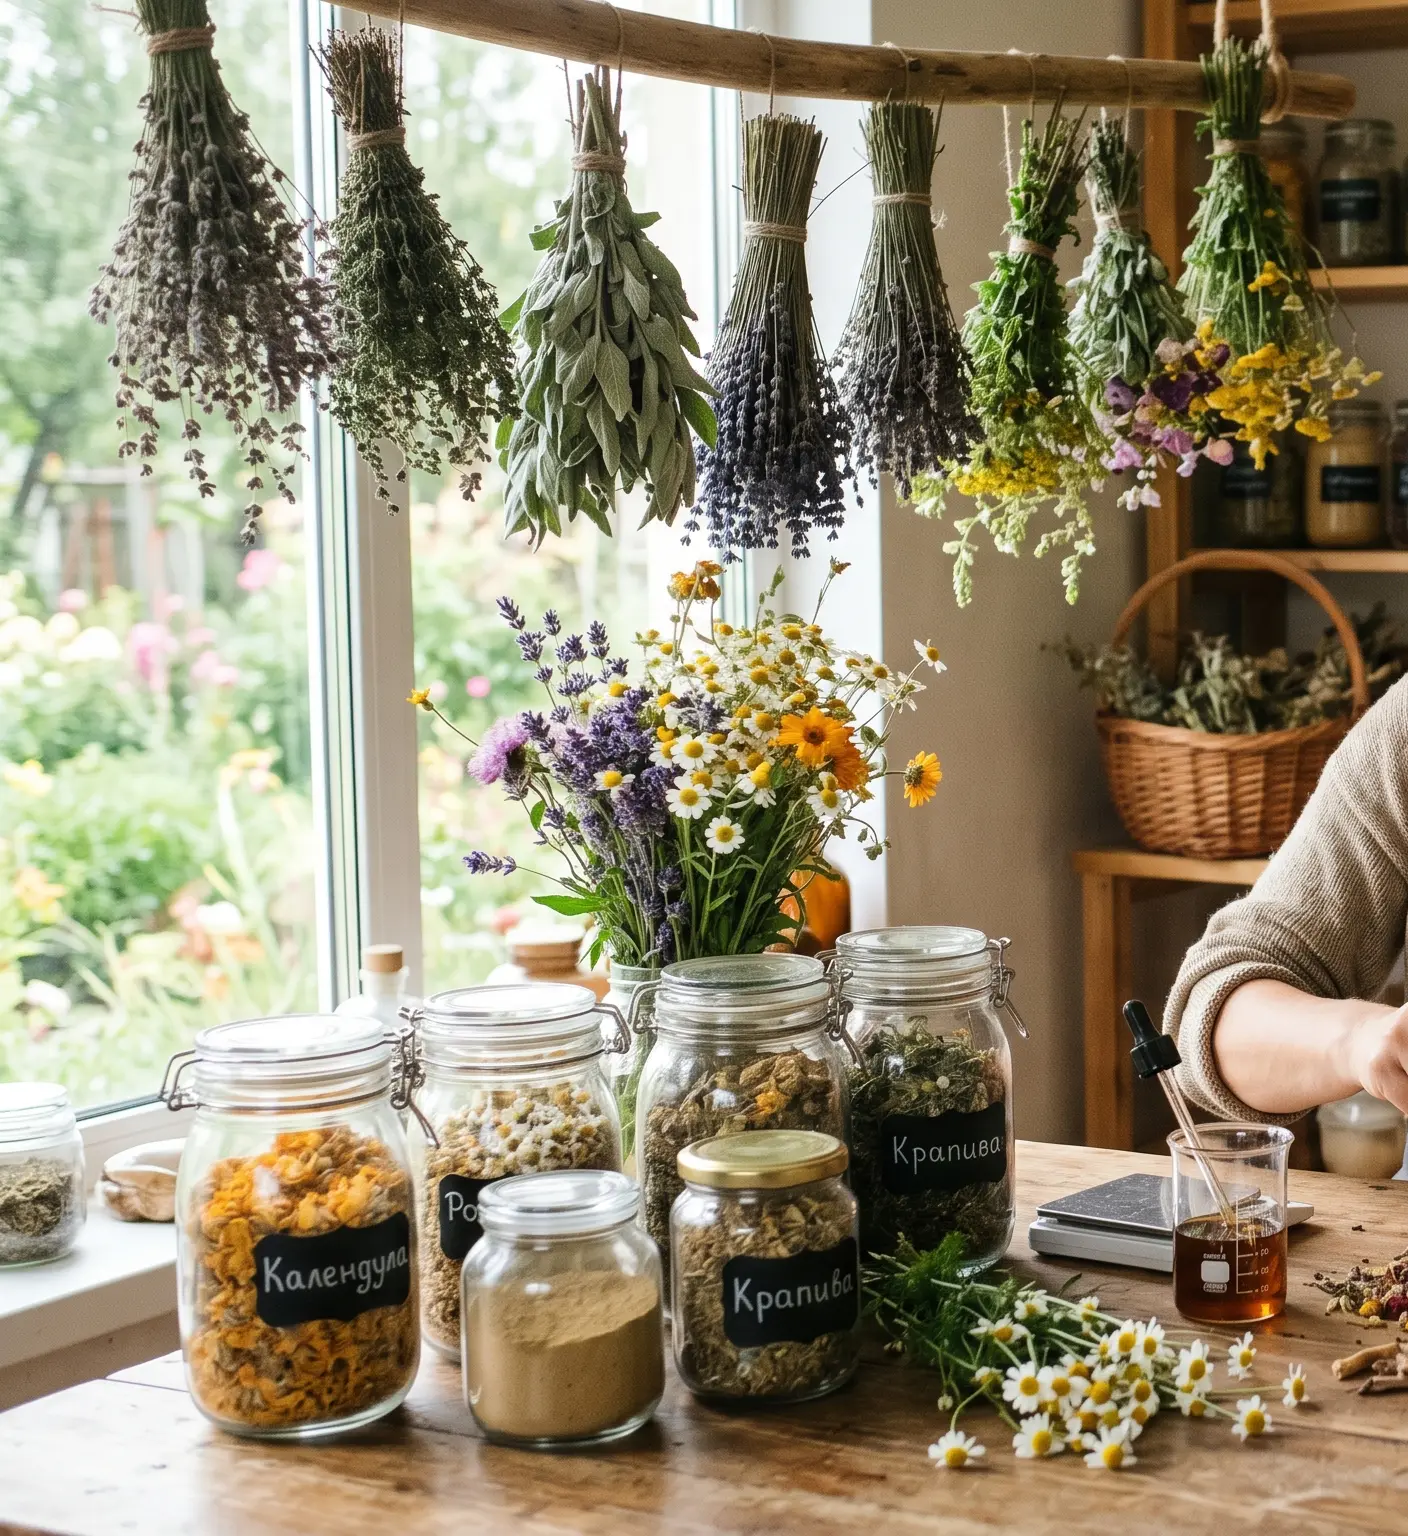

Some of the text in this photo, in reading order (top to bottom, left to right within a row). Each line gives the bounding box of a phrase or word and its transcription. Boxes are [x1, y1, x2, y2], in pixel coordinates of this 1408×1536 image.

[892, 1135, 1001, 1175] Крапива
[263, 1246, 409, 1294] Календула
[733, 1267, 854, 1324] Крапива
